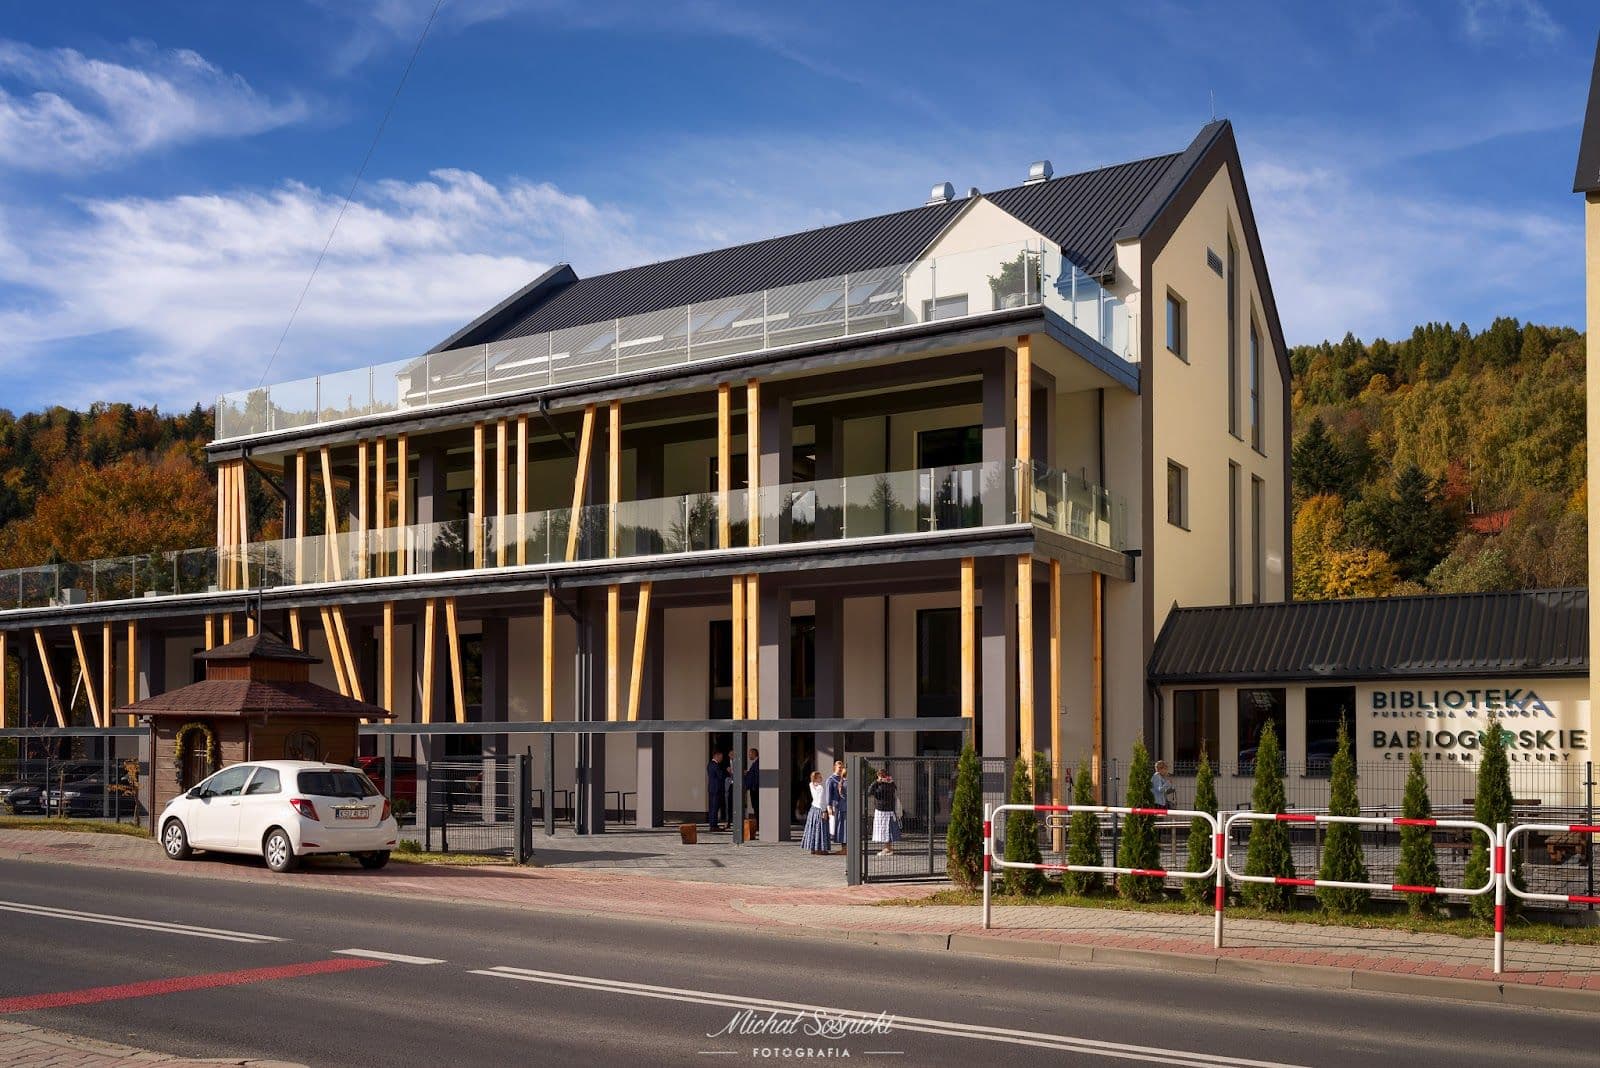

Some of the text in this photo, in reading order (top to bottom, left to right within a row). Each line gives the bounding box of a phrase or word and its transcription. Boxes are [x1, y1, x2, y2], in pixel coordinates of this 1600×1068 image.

[1373, 689, 1555, 718] BIBLIOTEKA
[1466, 710, 1476, 718] W
[1384, 752, 1471, 761] CETRUM
